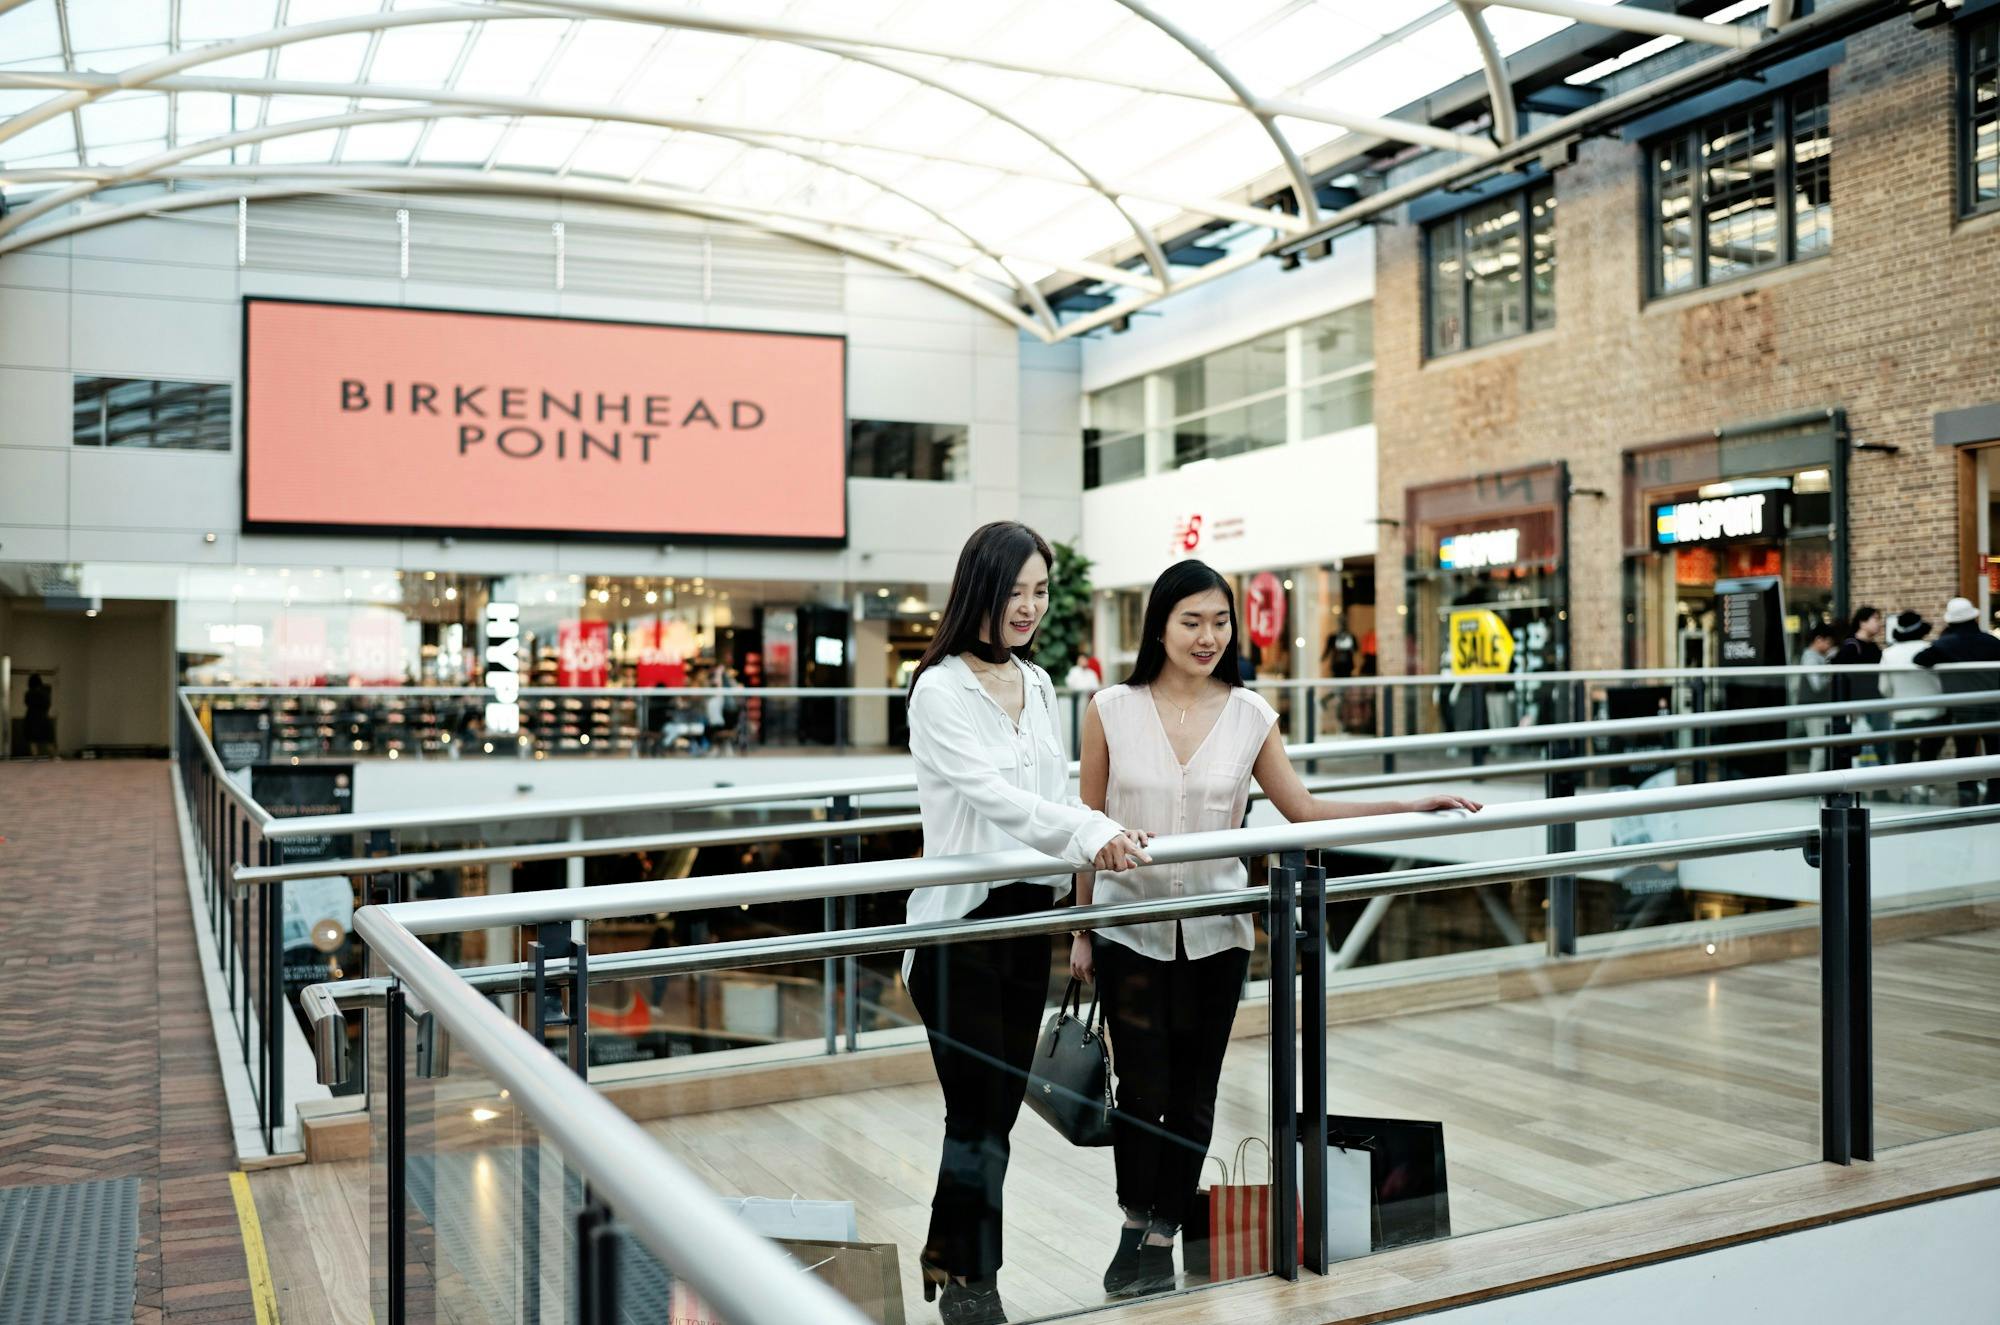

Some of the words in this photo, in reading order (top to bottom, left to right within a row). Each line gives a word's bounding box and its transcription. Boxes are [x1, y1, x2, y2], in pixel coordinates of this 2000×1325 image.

[340, 379, 766, 431] BIRKENHEAD
[458, 424, 658, 464] POINT
[485, 602, 520, 734] HYPE
[1457, 632, 1504, 669] SALE
